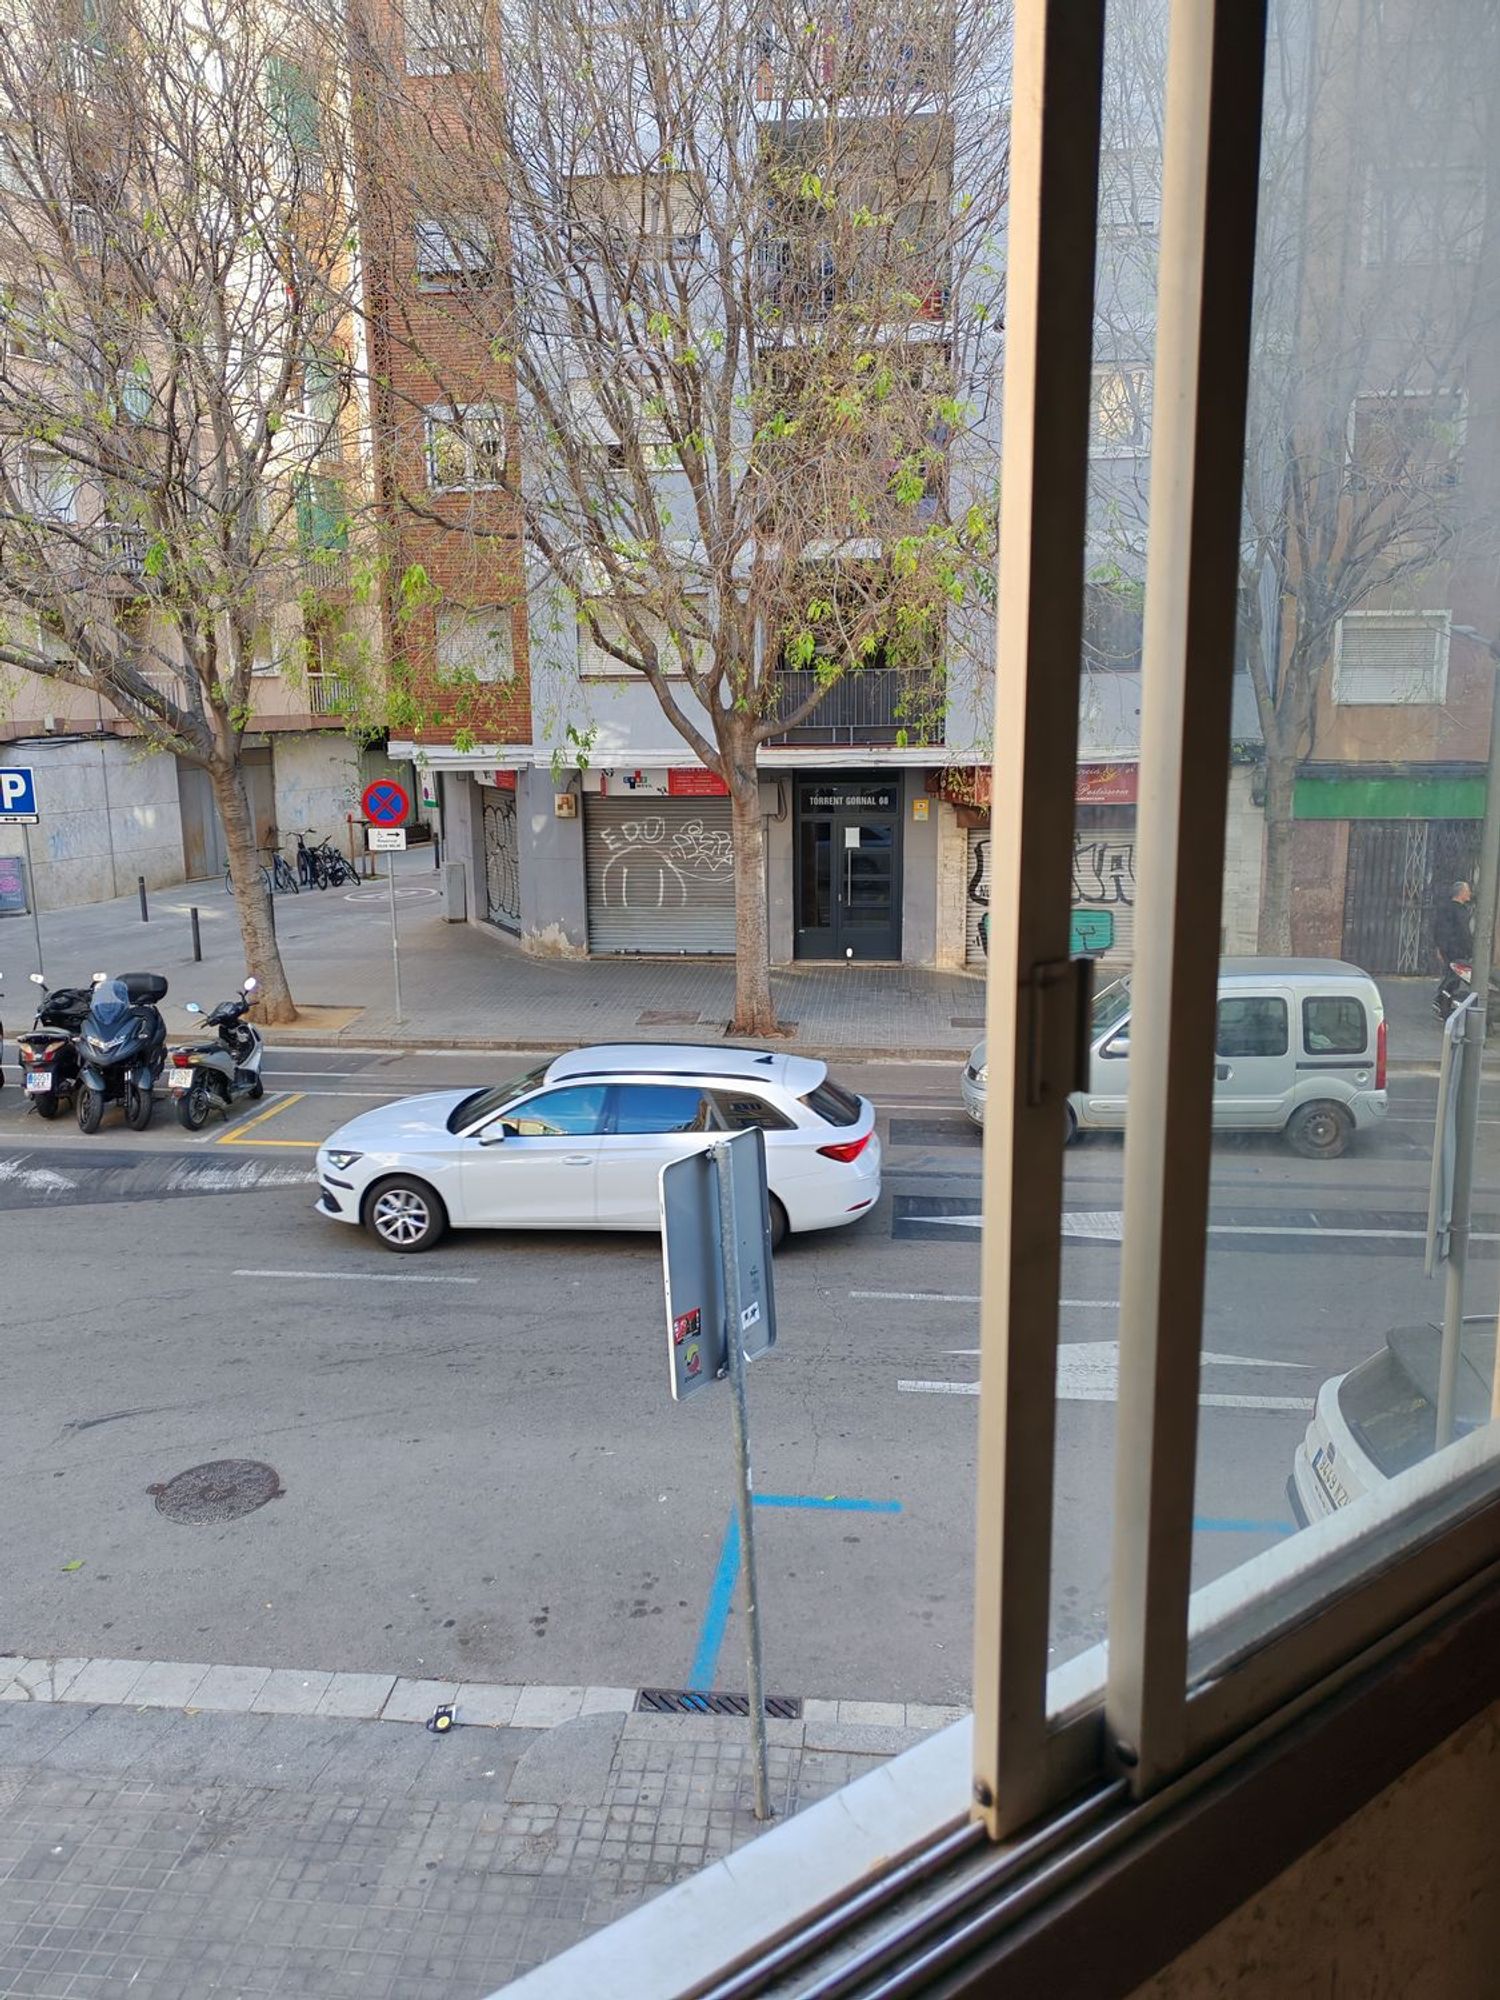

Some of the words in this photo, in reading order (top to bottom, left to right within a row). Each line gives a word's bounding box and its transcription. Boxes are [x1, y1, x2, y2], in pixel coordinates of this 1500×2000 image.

[1, 773, 26, 809] P
[809, 796, 843, 805] TORRENT
[845, 796, 876, 805] GORNAL
